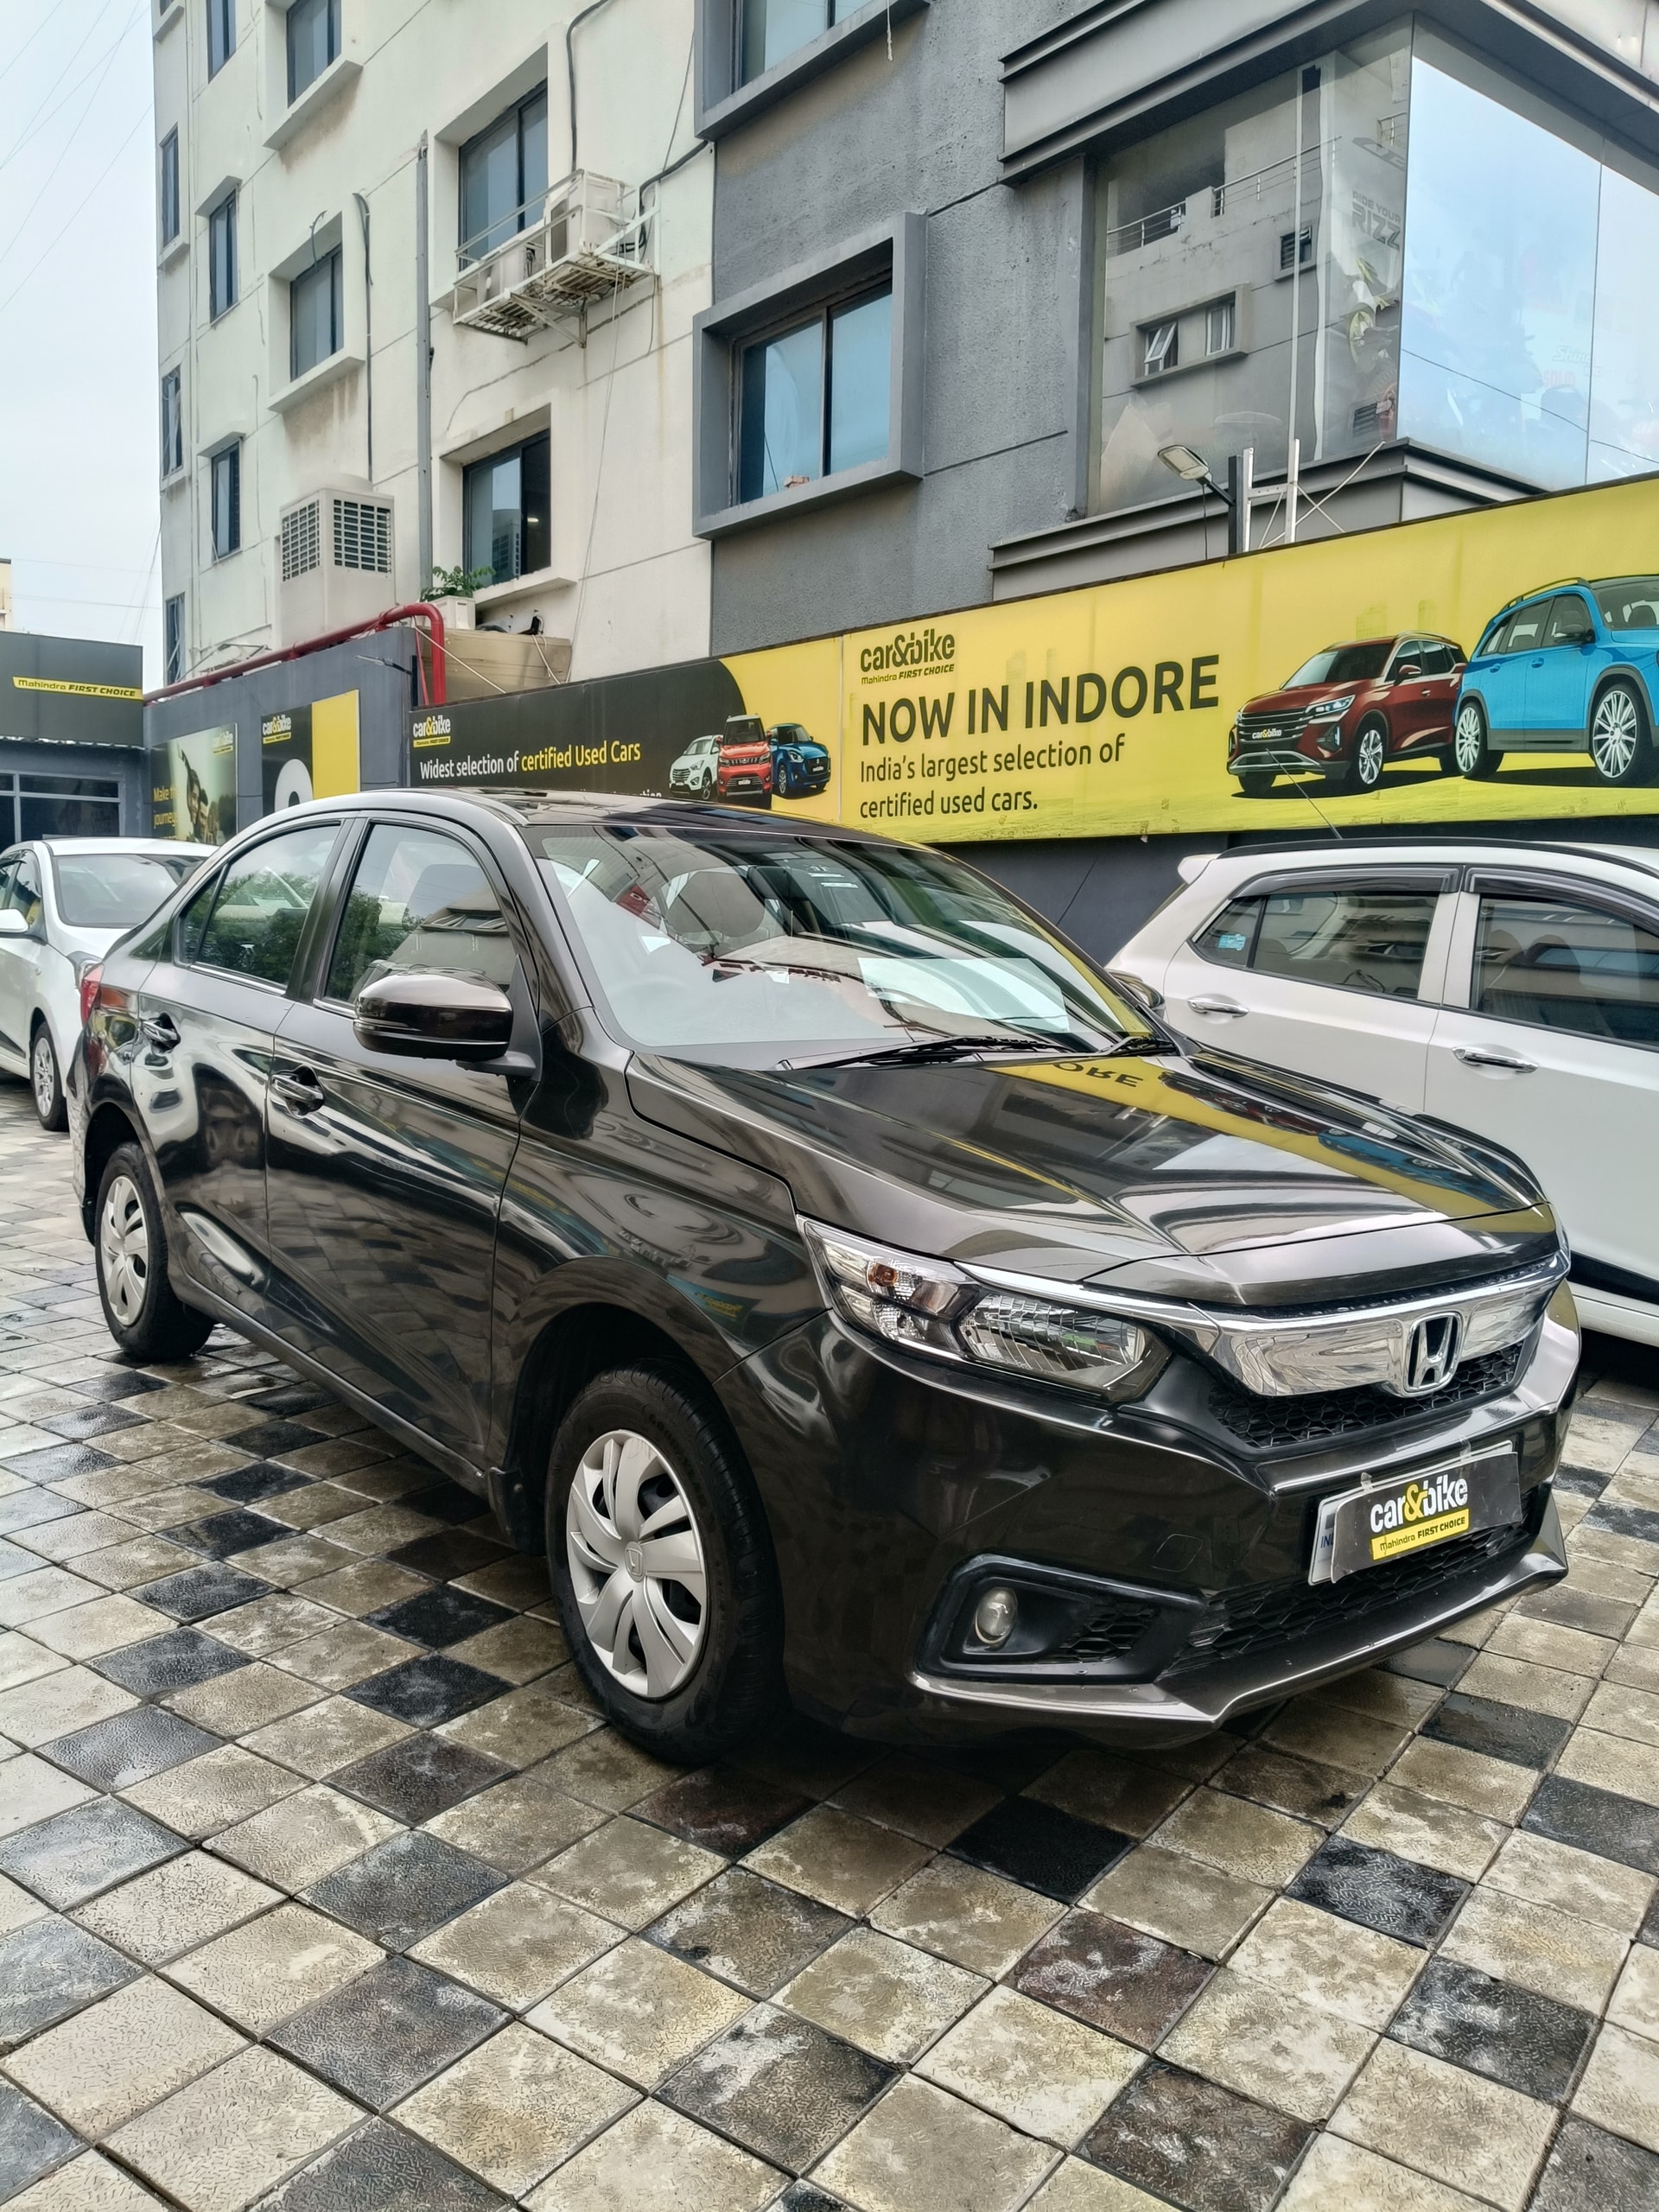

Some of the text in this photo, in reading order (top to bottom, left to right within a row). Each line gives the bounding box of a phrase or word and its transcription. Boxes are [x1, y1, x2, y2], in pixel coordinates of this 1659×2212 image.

[1352, 190, 1402, 225] RIDE YOUR
[1352, 201, 1402, 252] RIZZ
[860, 628, 956, 674] car&bike
[17, 679, 136, 697] Mahindra FIRST CHOICE
[861, 663, 955, 685] Mahindra FIRST CHOICE
[862, 654, 1220, 747] NOW IN INDORE
[412, 715, 451, 738] car&bike
[419, 740, 641, 779] Widest selection of certified Used Cars
[860, 733, 1126, 783] India's largest selection of
[153, 785, 169, 802] Make
[860, 786, 1039, 819] certified used cars.
[1370, 1474, 1469, 1533] car&bike
[1379, 1516, 1466, 1552] Mahindra FIRST CHOICE
